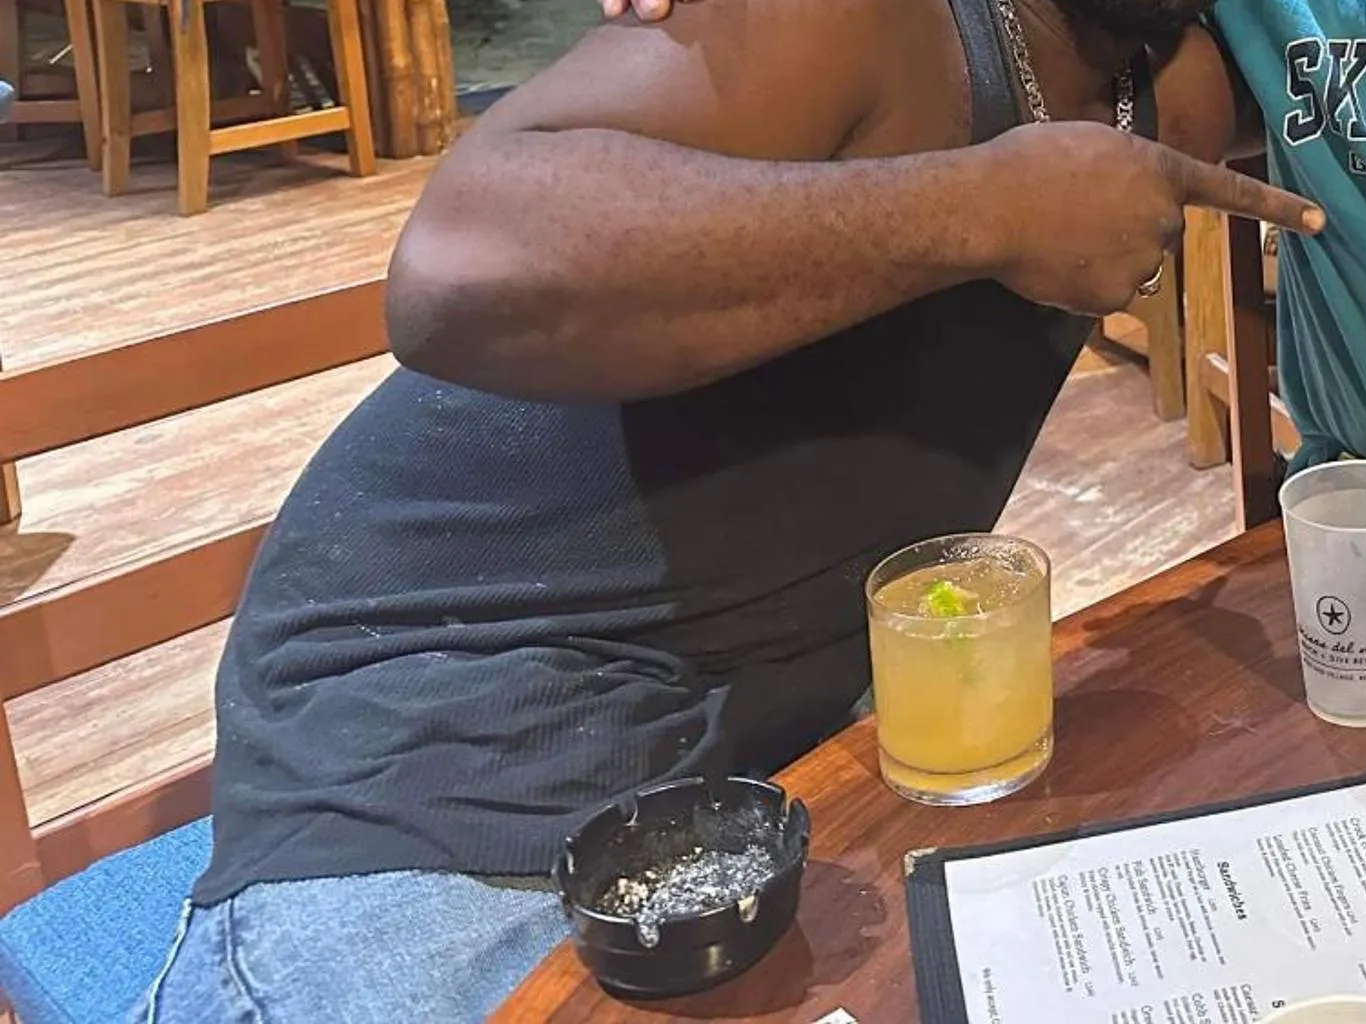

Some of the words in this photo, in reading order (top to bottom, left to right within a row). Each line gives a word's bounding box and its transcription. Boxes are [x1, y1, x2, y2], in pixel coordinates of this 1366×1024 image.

[1331, 641, 1355, 653] del
[1187, 848, 1213, 891] Hamburger
[1215, 860, 1250, 920] Sandwiches
[1271, 834, 1293, 861] Loaded
[1284, 862, 1305, 889] Cheese
[1296, 890, 1314, 911] Fries
[1319, 855, 1342, 883] Chicken
[1331, 883, 1354, 910] Fingers
[1095, 866, 1113, 891] Crispy
[1105, 893, 1123, 925] Chicken
[1114, 925, 1135, 966] Sandwich
[1136, 877, 1159, 915] Sandwich
[1054, 873, 1072, 898] Cajun
[1063, 899, 1081, 932] Chicken
[1072, 933, 1091, 973] Sandwich
[1190, 991, 1209, 1017] Cobb
[1239, 983, 1261, 1014] Caesar
